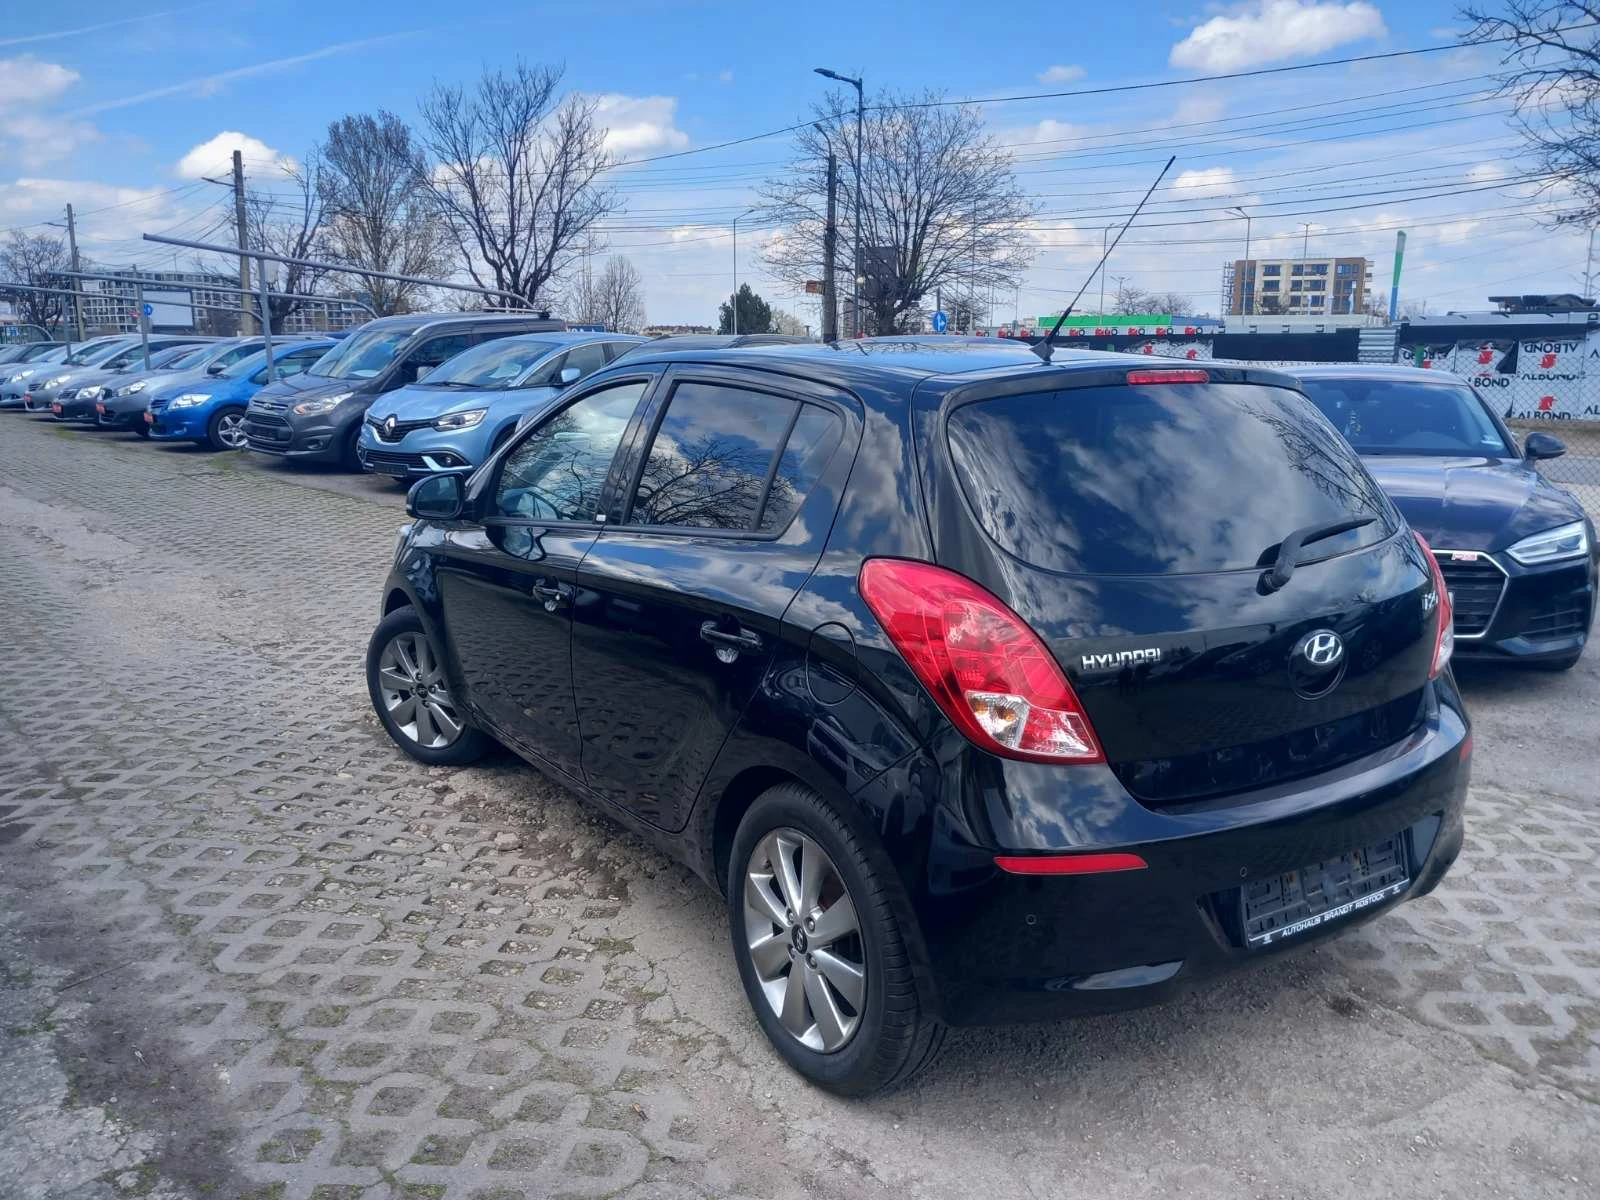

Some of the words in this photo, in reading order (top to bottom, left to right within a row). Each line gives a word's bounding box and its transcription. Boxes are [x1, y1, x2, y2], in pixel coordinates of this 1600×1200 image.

[1524, 343, 1578, 353] ALBOND
[1468, 377, 1510, 388] BOND
[1082, 647, 1161, 670] HYUNDAI
[1282, 917, 1321, 937] AUTOHAUS
[1324, 904, 1353, 921] BRANDT
[1355, 893, 1385, 909] ROSTOCK
